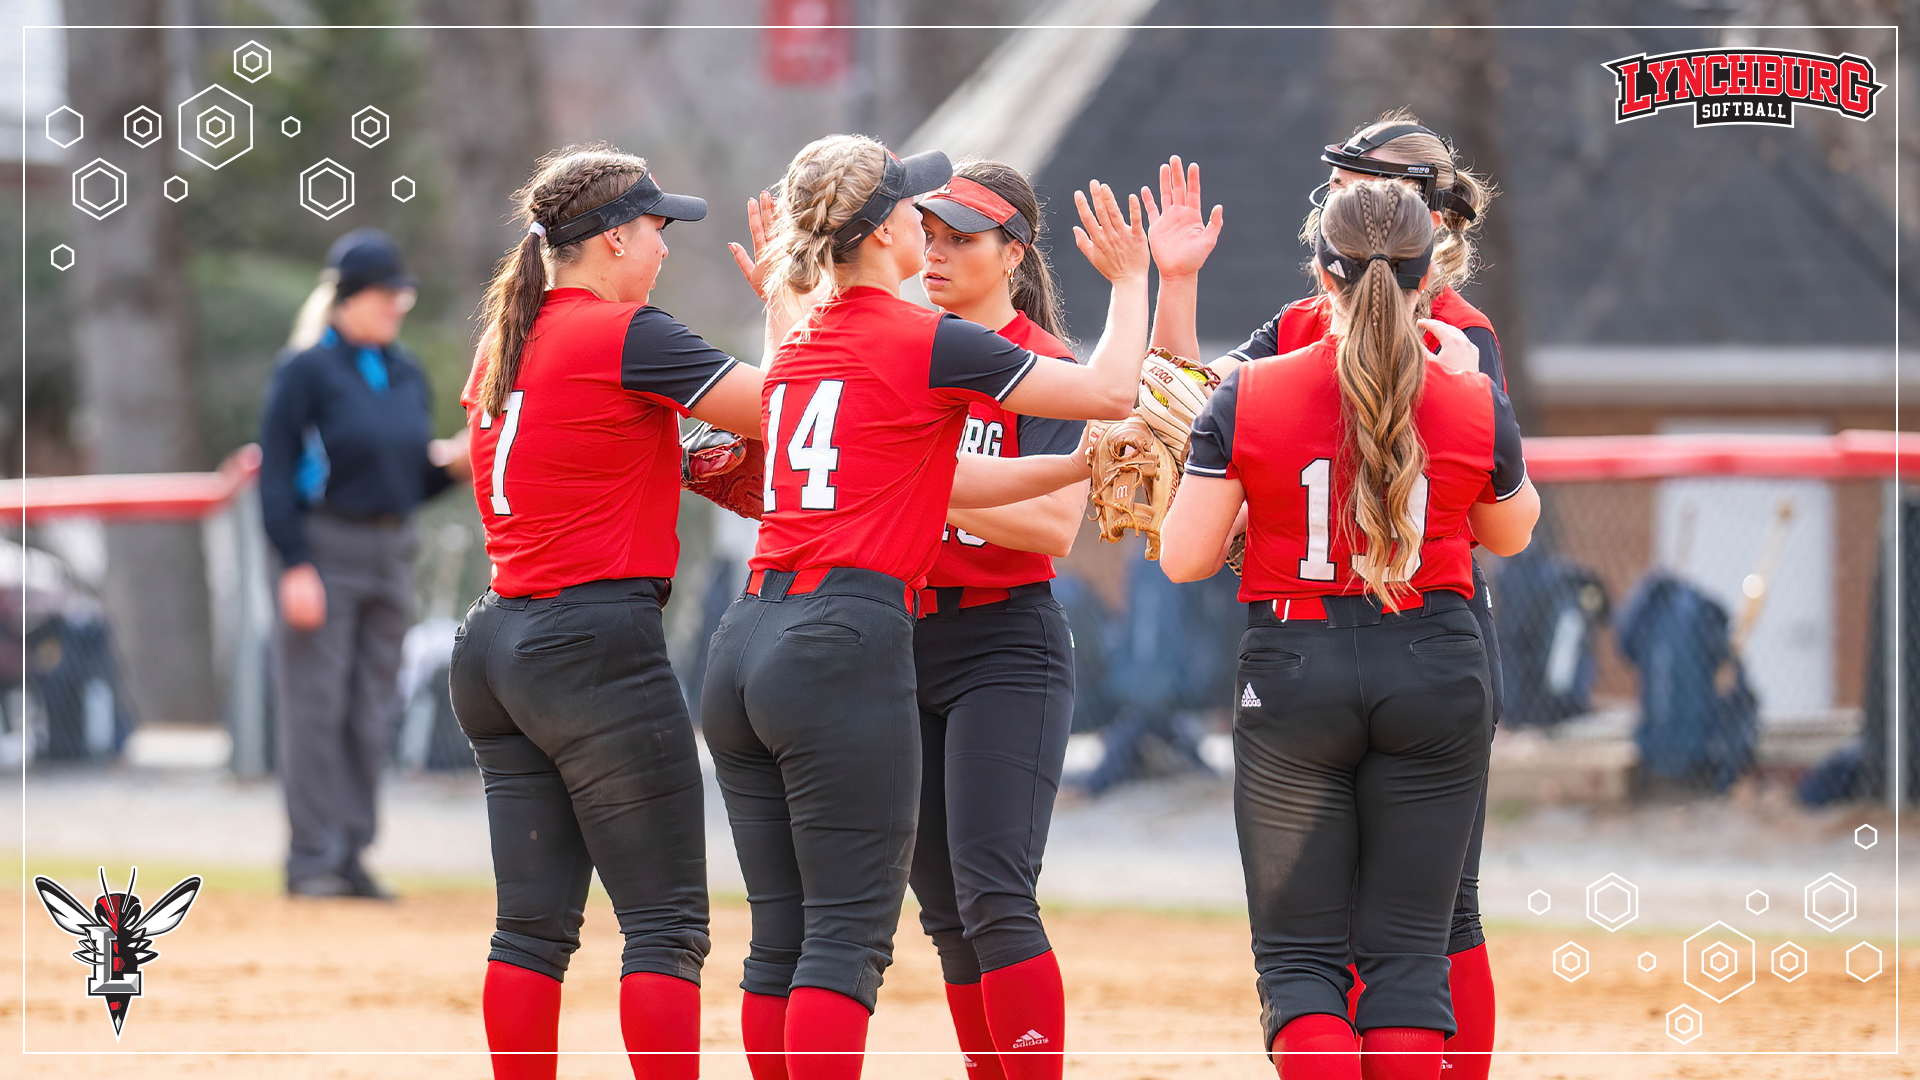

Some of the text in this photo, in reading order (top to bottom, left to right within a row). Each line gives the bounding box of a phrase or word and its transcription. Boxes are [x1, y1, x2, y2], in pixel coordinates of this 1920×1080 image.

[479, 390, 525, 516] 7
[763, 379, 845, 513] 14
[956, 414, 1004, 460] RG
[1012, 1037, 1049, 1049] adidas
